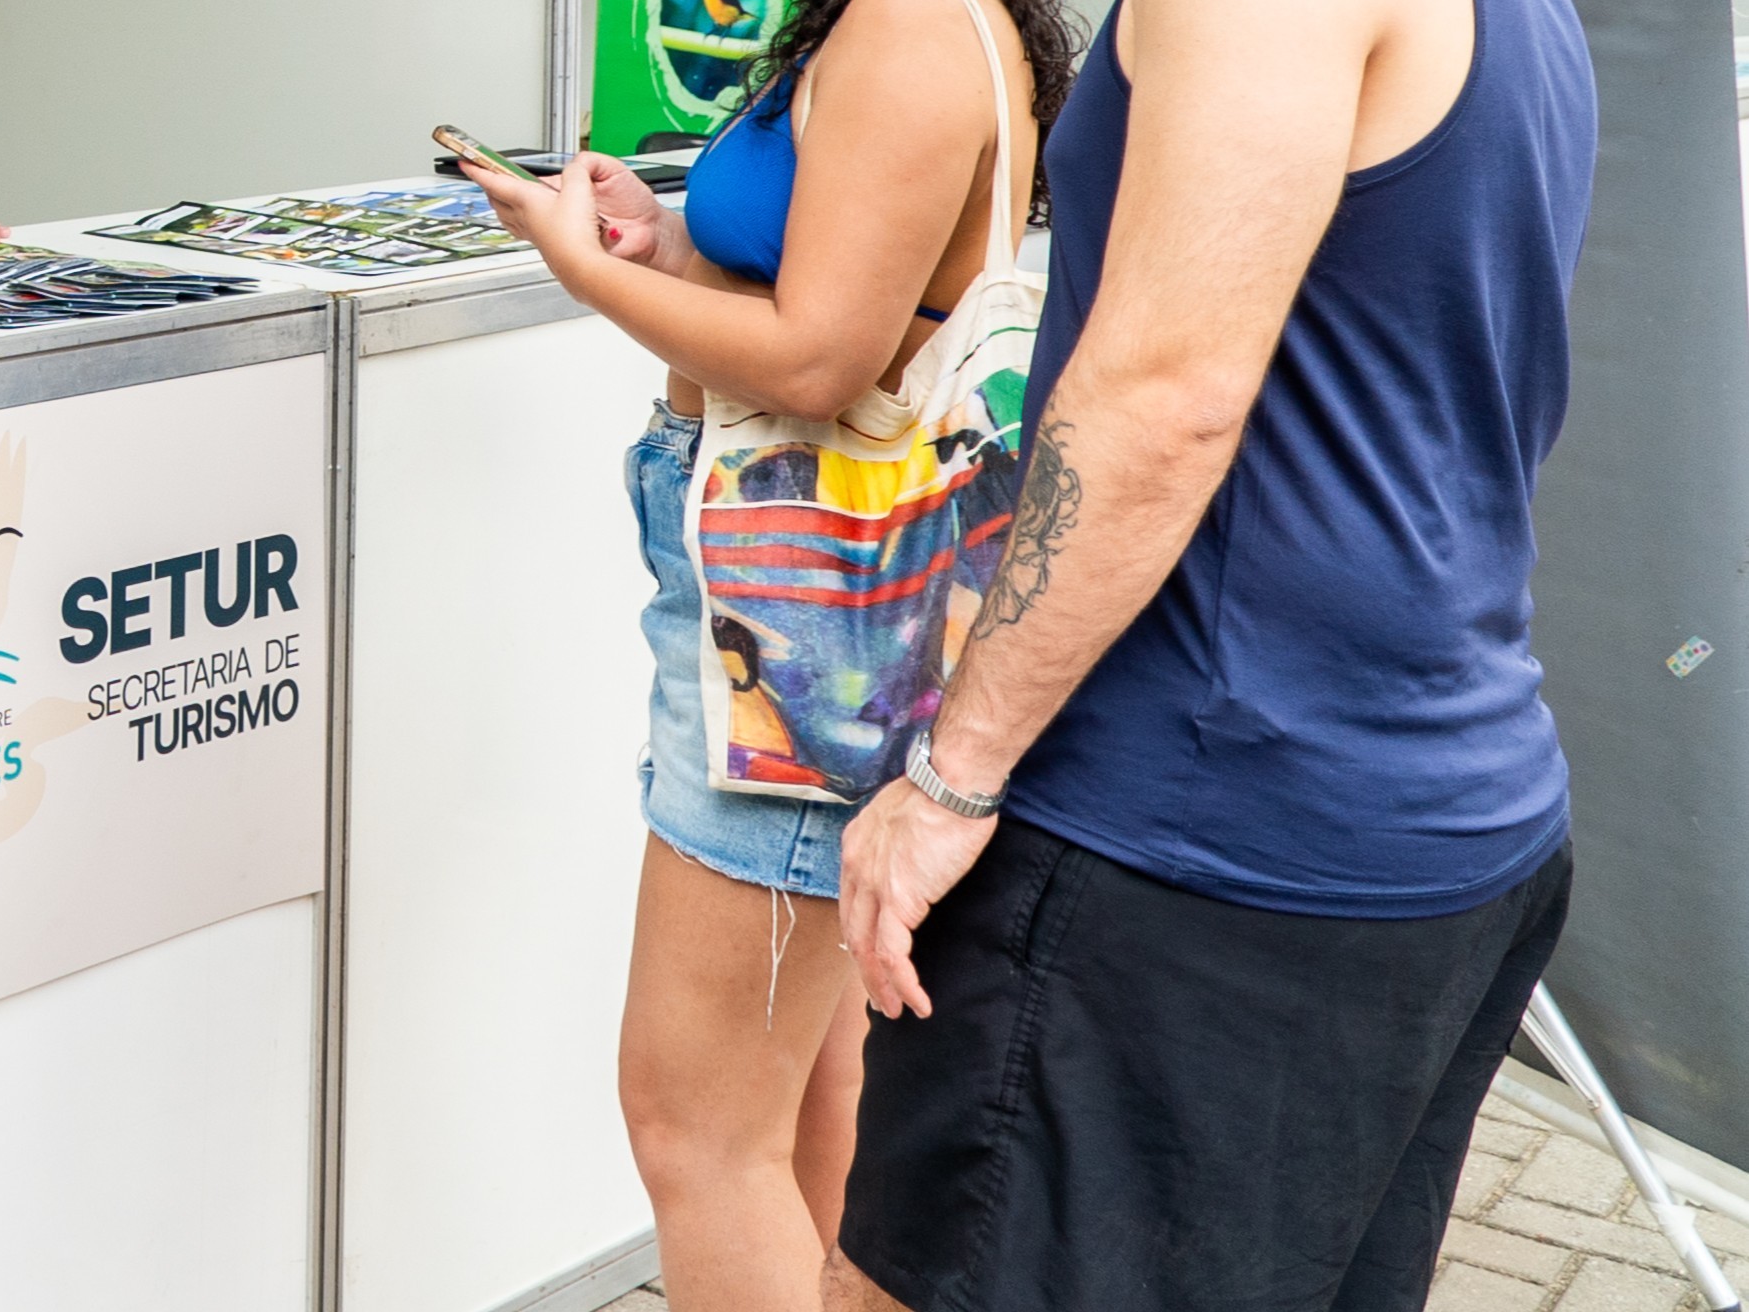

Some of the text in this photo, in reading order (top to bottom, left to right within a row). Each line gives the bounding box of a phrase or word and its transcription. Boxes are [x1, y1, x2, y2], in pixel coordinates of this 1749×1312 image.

[59, 533, 300, 664] SETUR
[87, 633, 300, 721] SECRETARIA DE
[129, 678, 300, 762] TURISMO
